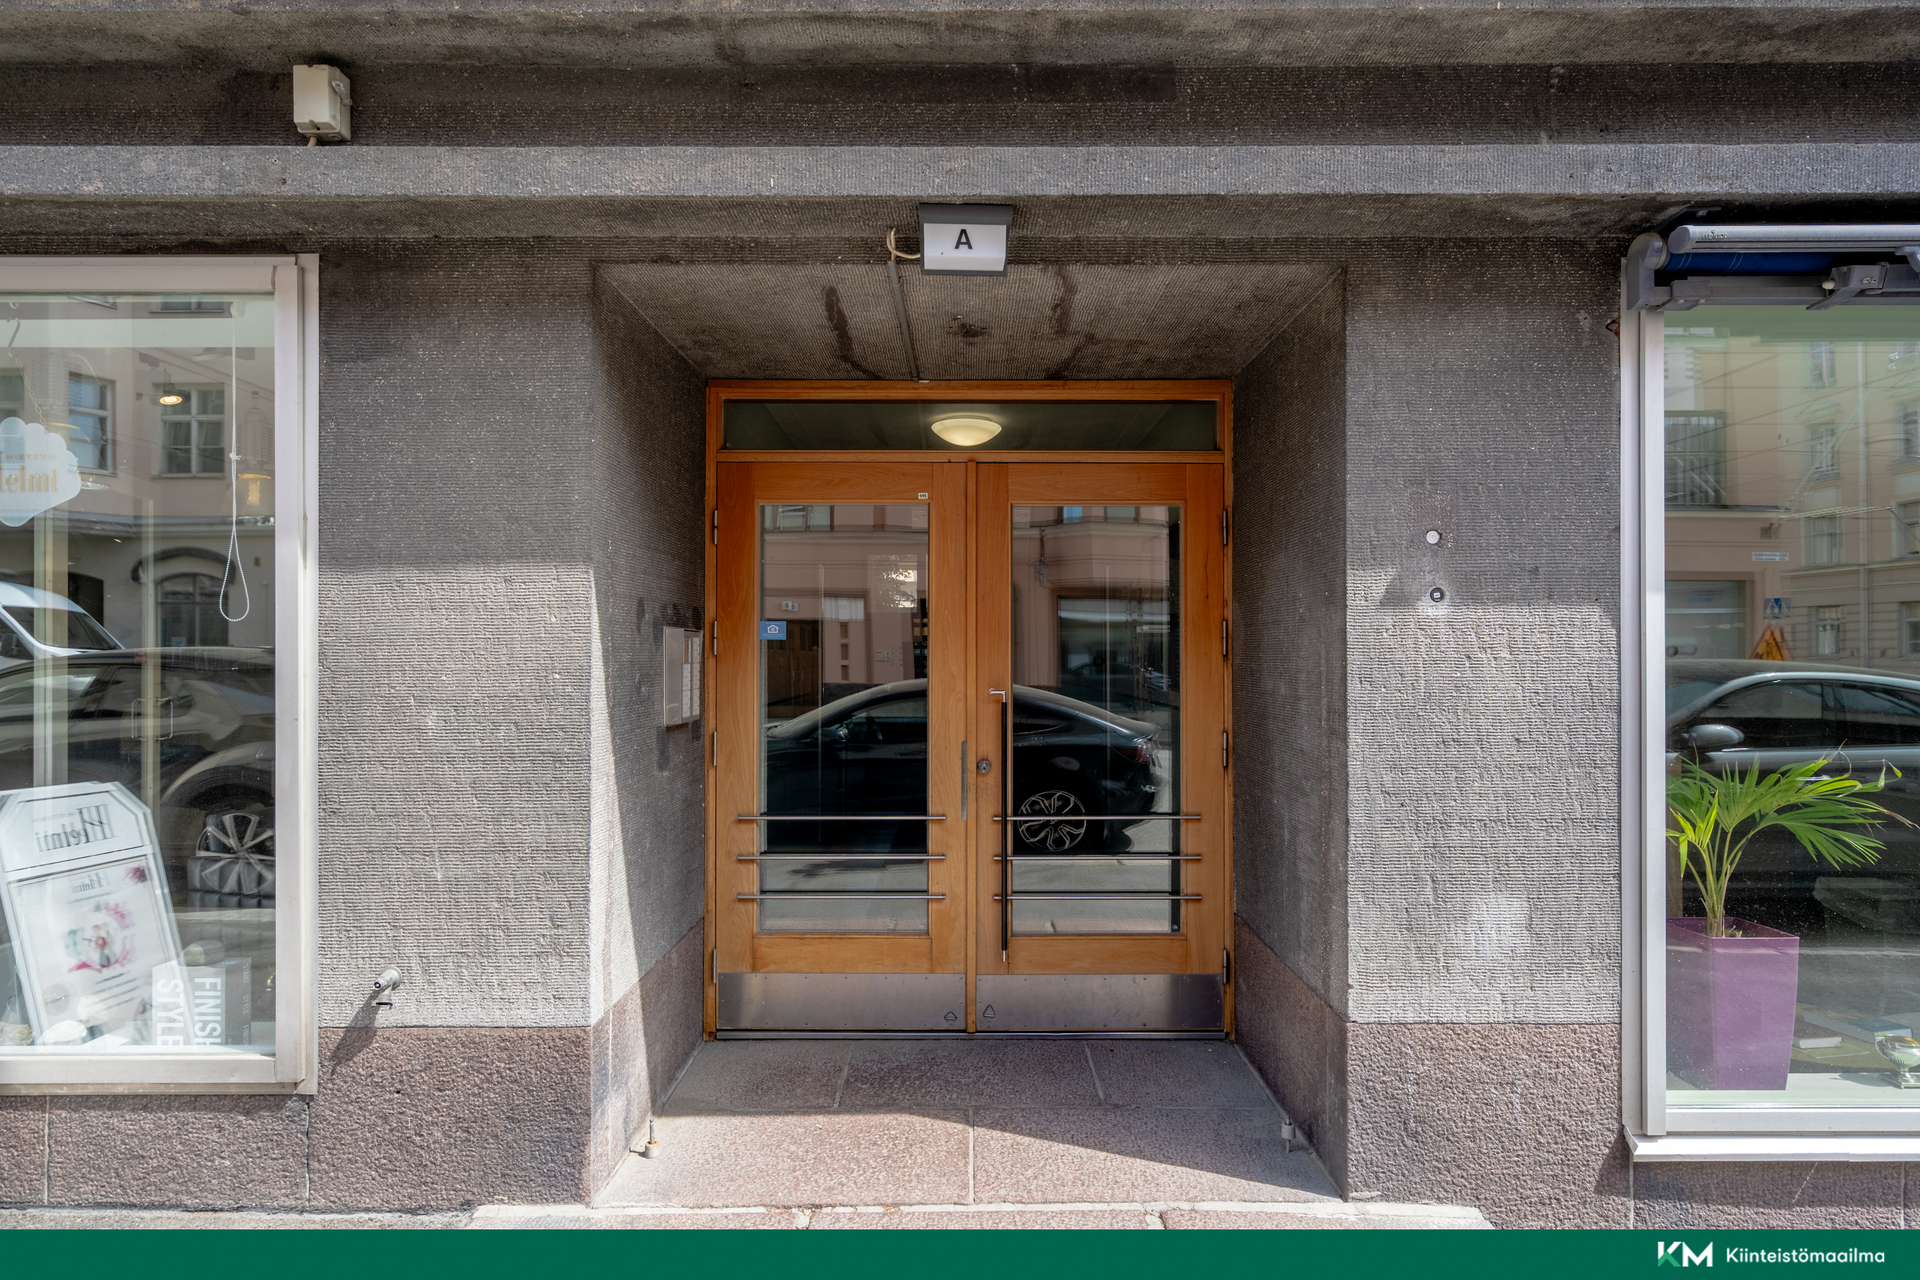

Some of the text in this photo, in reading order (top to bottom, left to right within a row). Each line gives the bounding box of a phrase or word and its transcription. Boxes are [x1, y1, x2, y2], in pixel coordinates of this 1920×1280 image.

[954, 229, 973, 250] A
[0, 451, 57, 493] elmi
[156, 979, 184, 1045] STYLE
